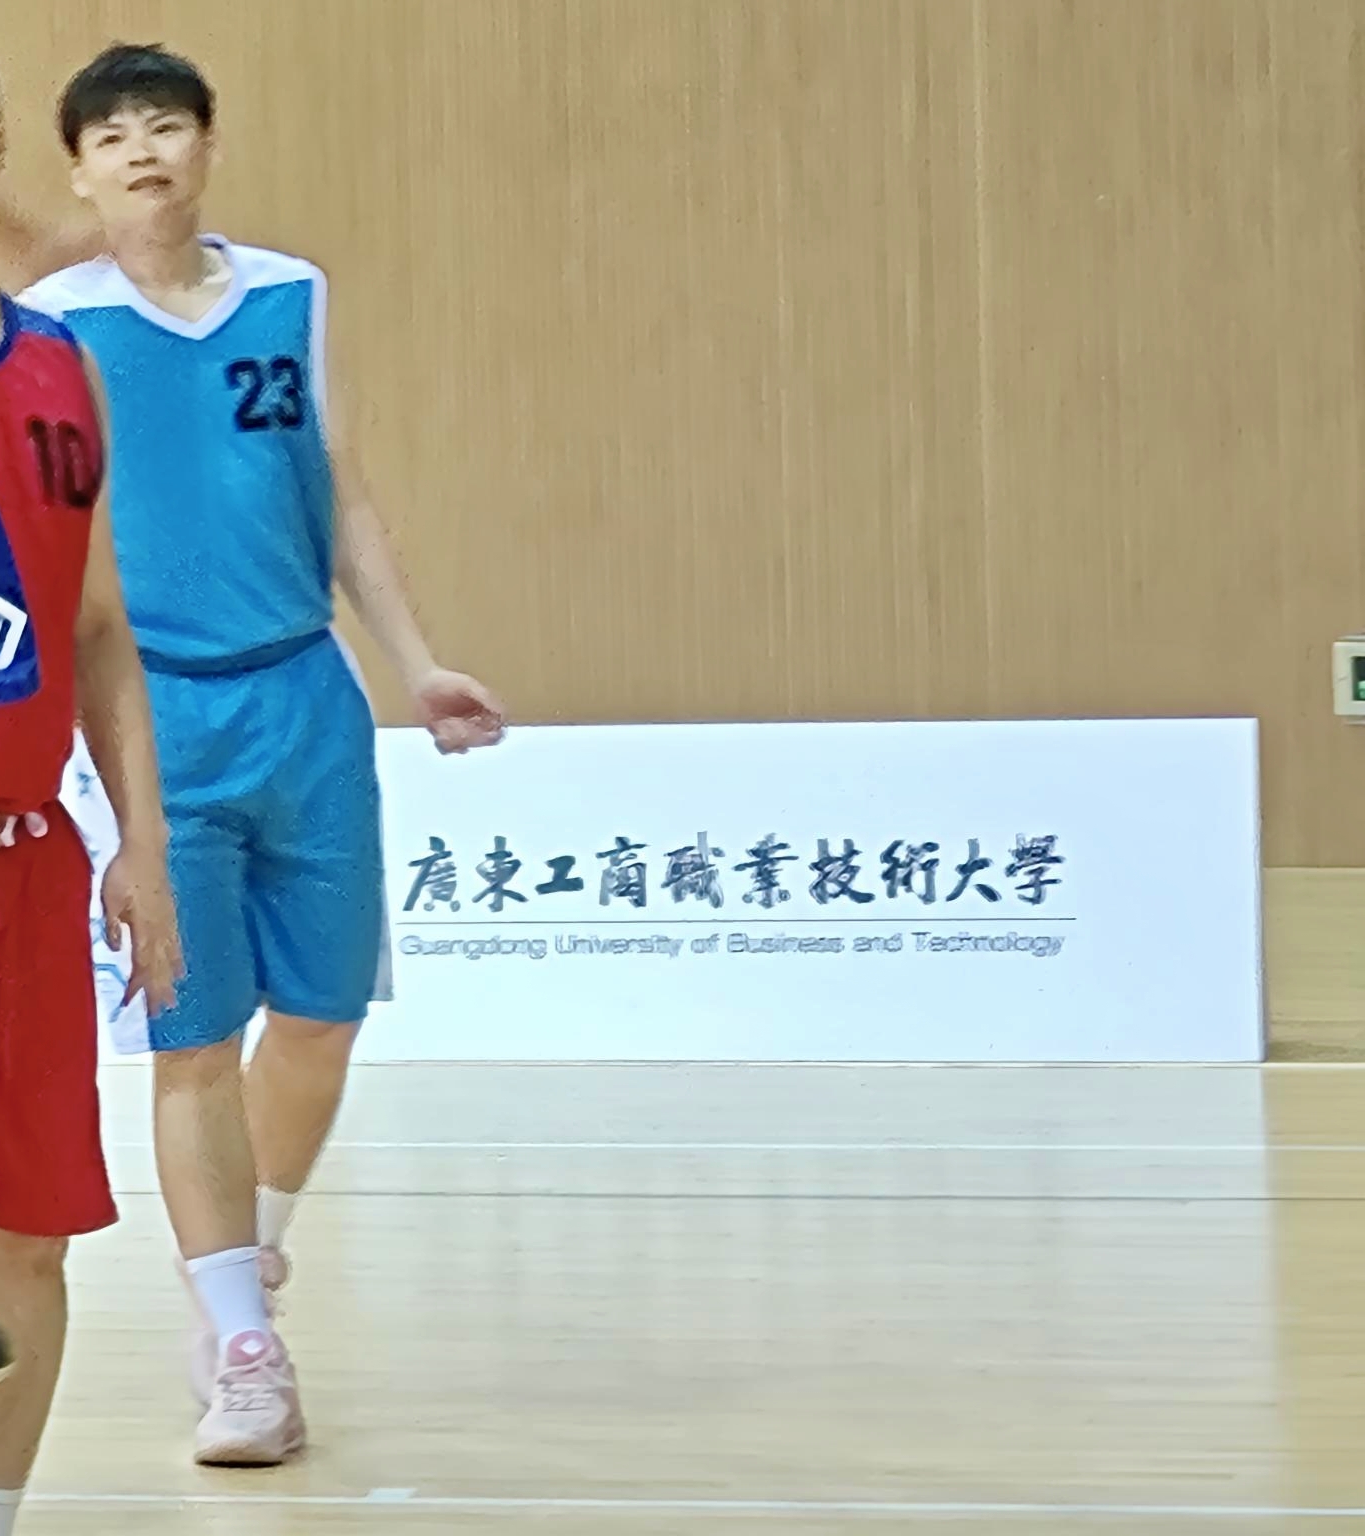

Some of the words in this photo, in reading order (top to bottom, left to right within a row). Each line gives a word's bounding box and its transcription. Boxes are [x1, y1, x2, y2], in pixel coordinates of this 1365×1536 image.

[224, 354, 305, 433] 23
[397, 933, 548, 959] Guangdong
[554, 932, 685, 957] University
[690, 932, 720, 954] of
[727, 932, 846, 954] Business
[852, 932, 904, 954] and
[910, 931, 1066, 958] Technology
